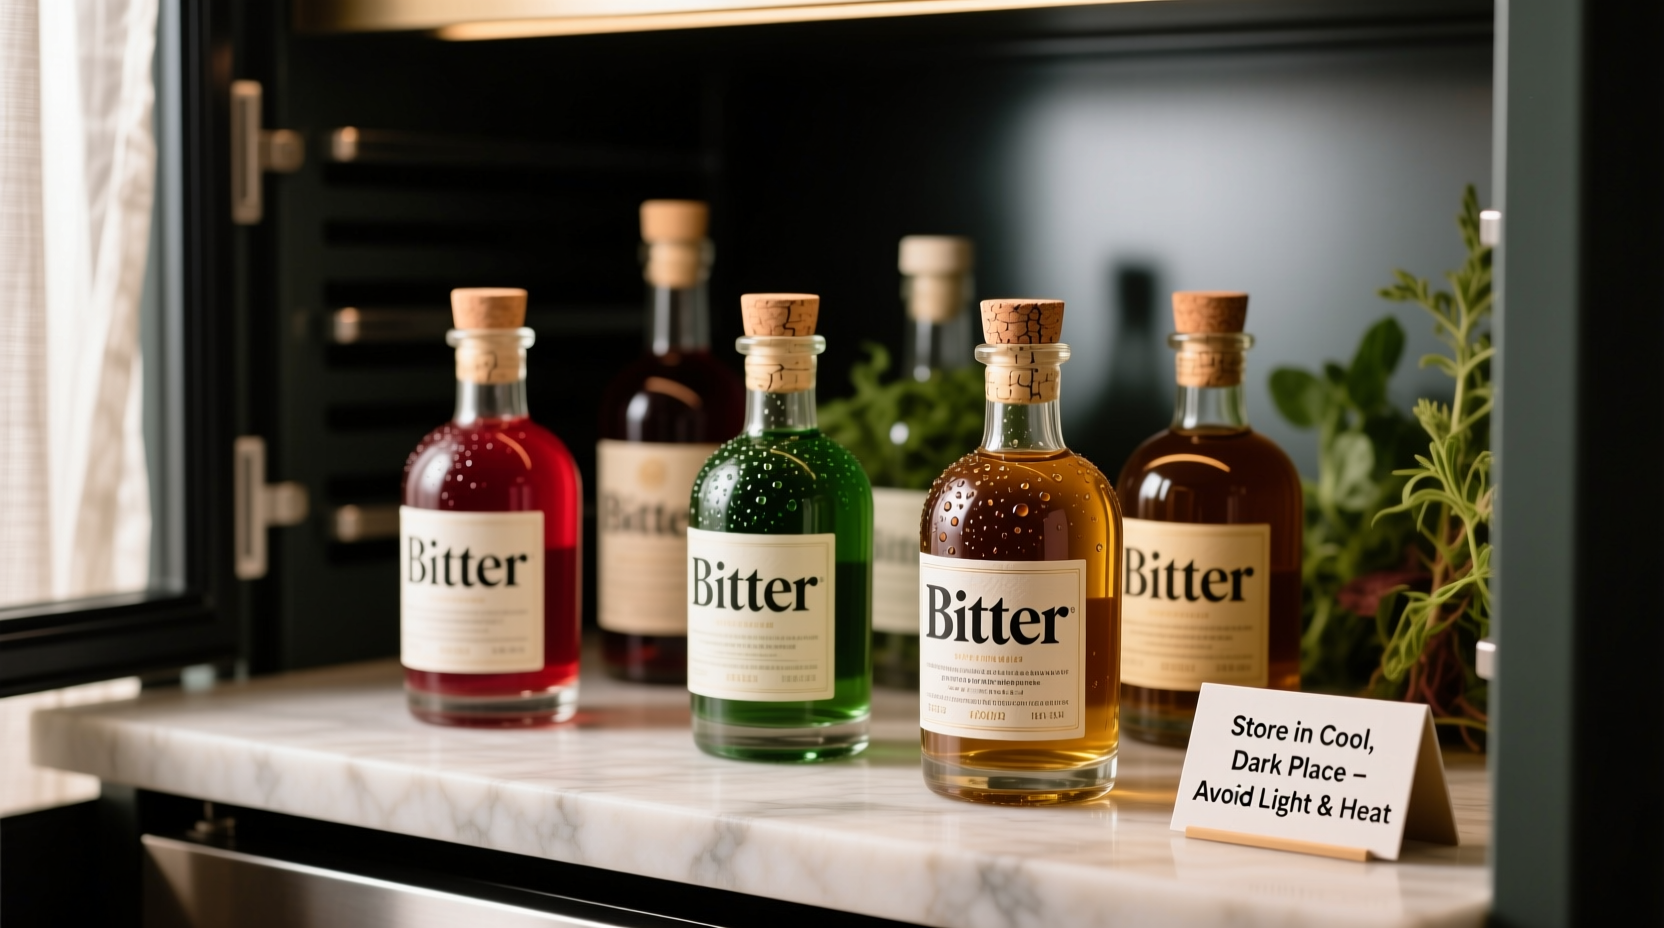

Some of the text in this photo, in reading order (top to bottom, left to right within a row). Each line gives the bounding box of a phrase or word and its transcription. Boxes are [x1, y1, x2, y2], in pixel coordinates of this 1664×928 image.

[602, 491, 689, 537] Bitte
[408, 536, 528, 587] Bitter
[692, 556, 818, 612] Bitter
[1125, 547, 1254, 603] Bitter
[1231, 714, 1375, 754] Store in Cool,
[1231, 750, 1282, 775] Dark
[1288, 755, 1346, 782] Place
[1192, 780, 1392, 824] Avoid Light & Heat
